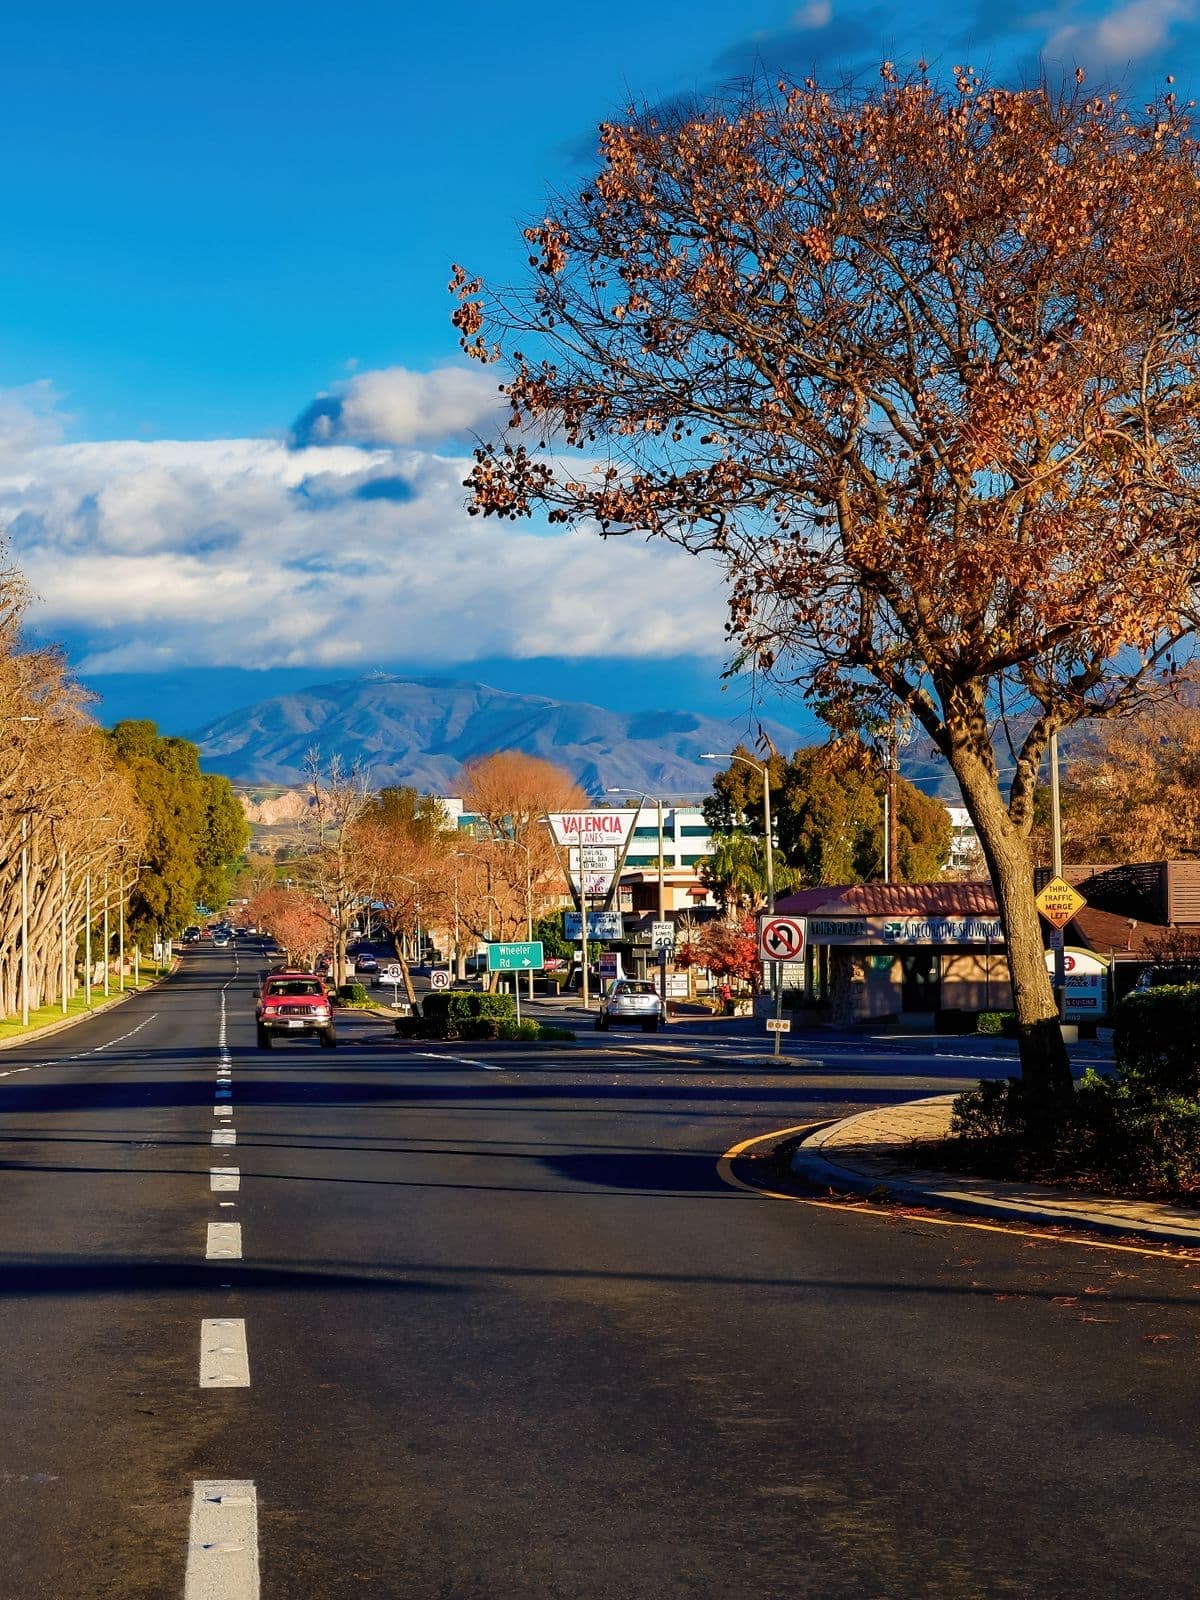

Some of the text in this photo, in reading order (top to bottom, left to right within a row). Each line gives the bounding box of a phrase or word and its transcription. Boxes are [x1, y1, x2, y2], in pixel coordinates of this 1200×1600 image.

[562, 816, 623, 833] VALENCIA
[581, 833, 604, 843] ANES
[904, 923, 911, 938] A
[912, 922, 957, 938] DECORATIVE
[655, 938, 671, 946] 40
[499, 946, 531, 955] Wheeler
[499, 959, 511, 968] Rd
